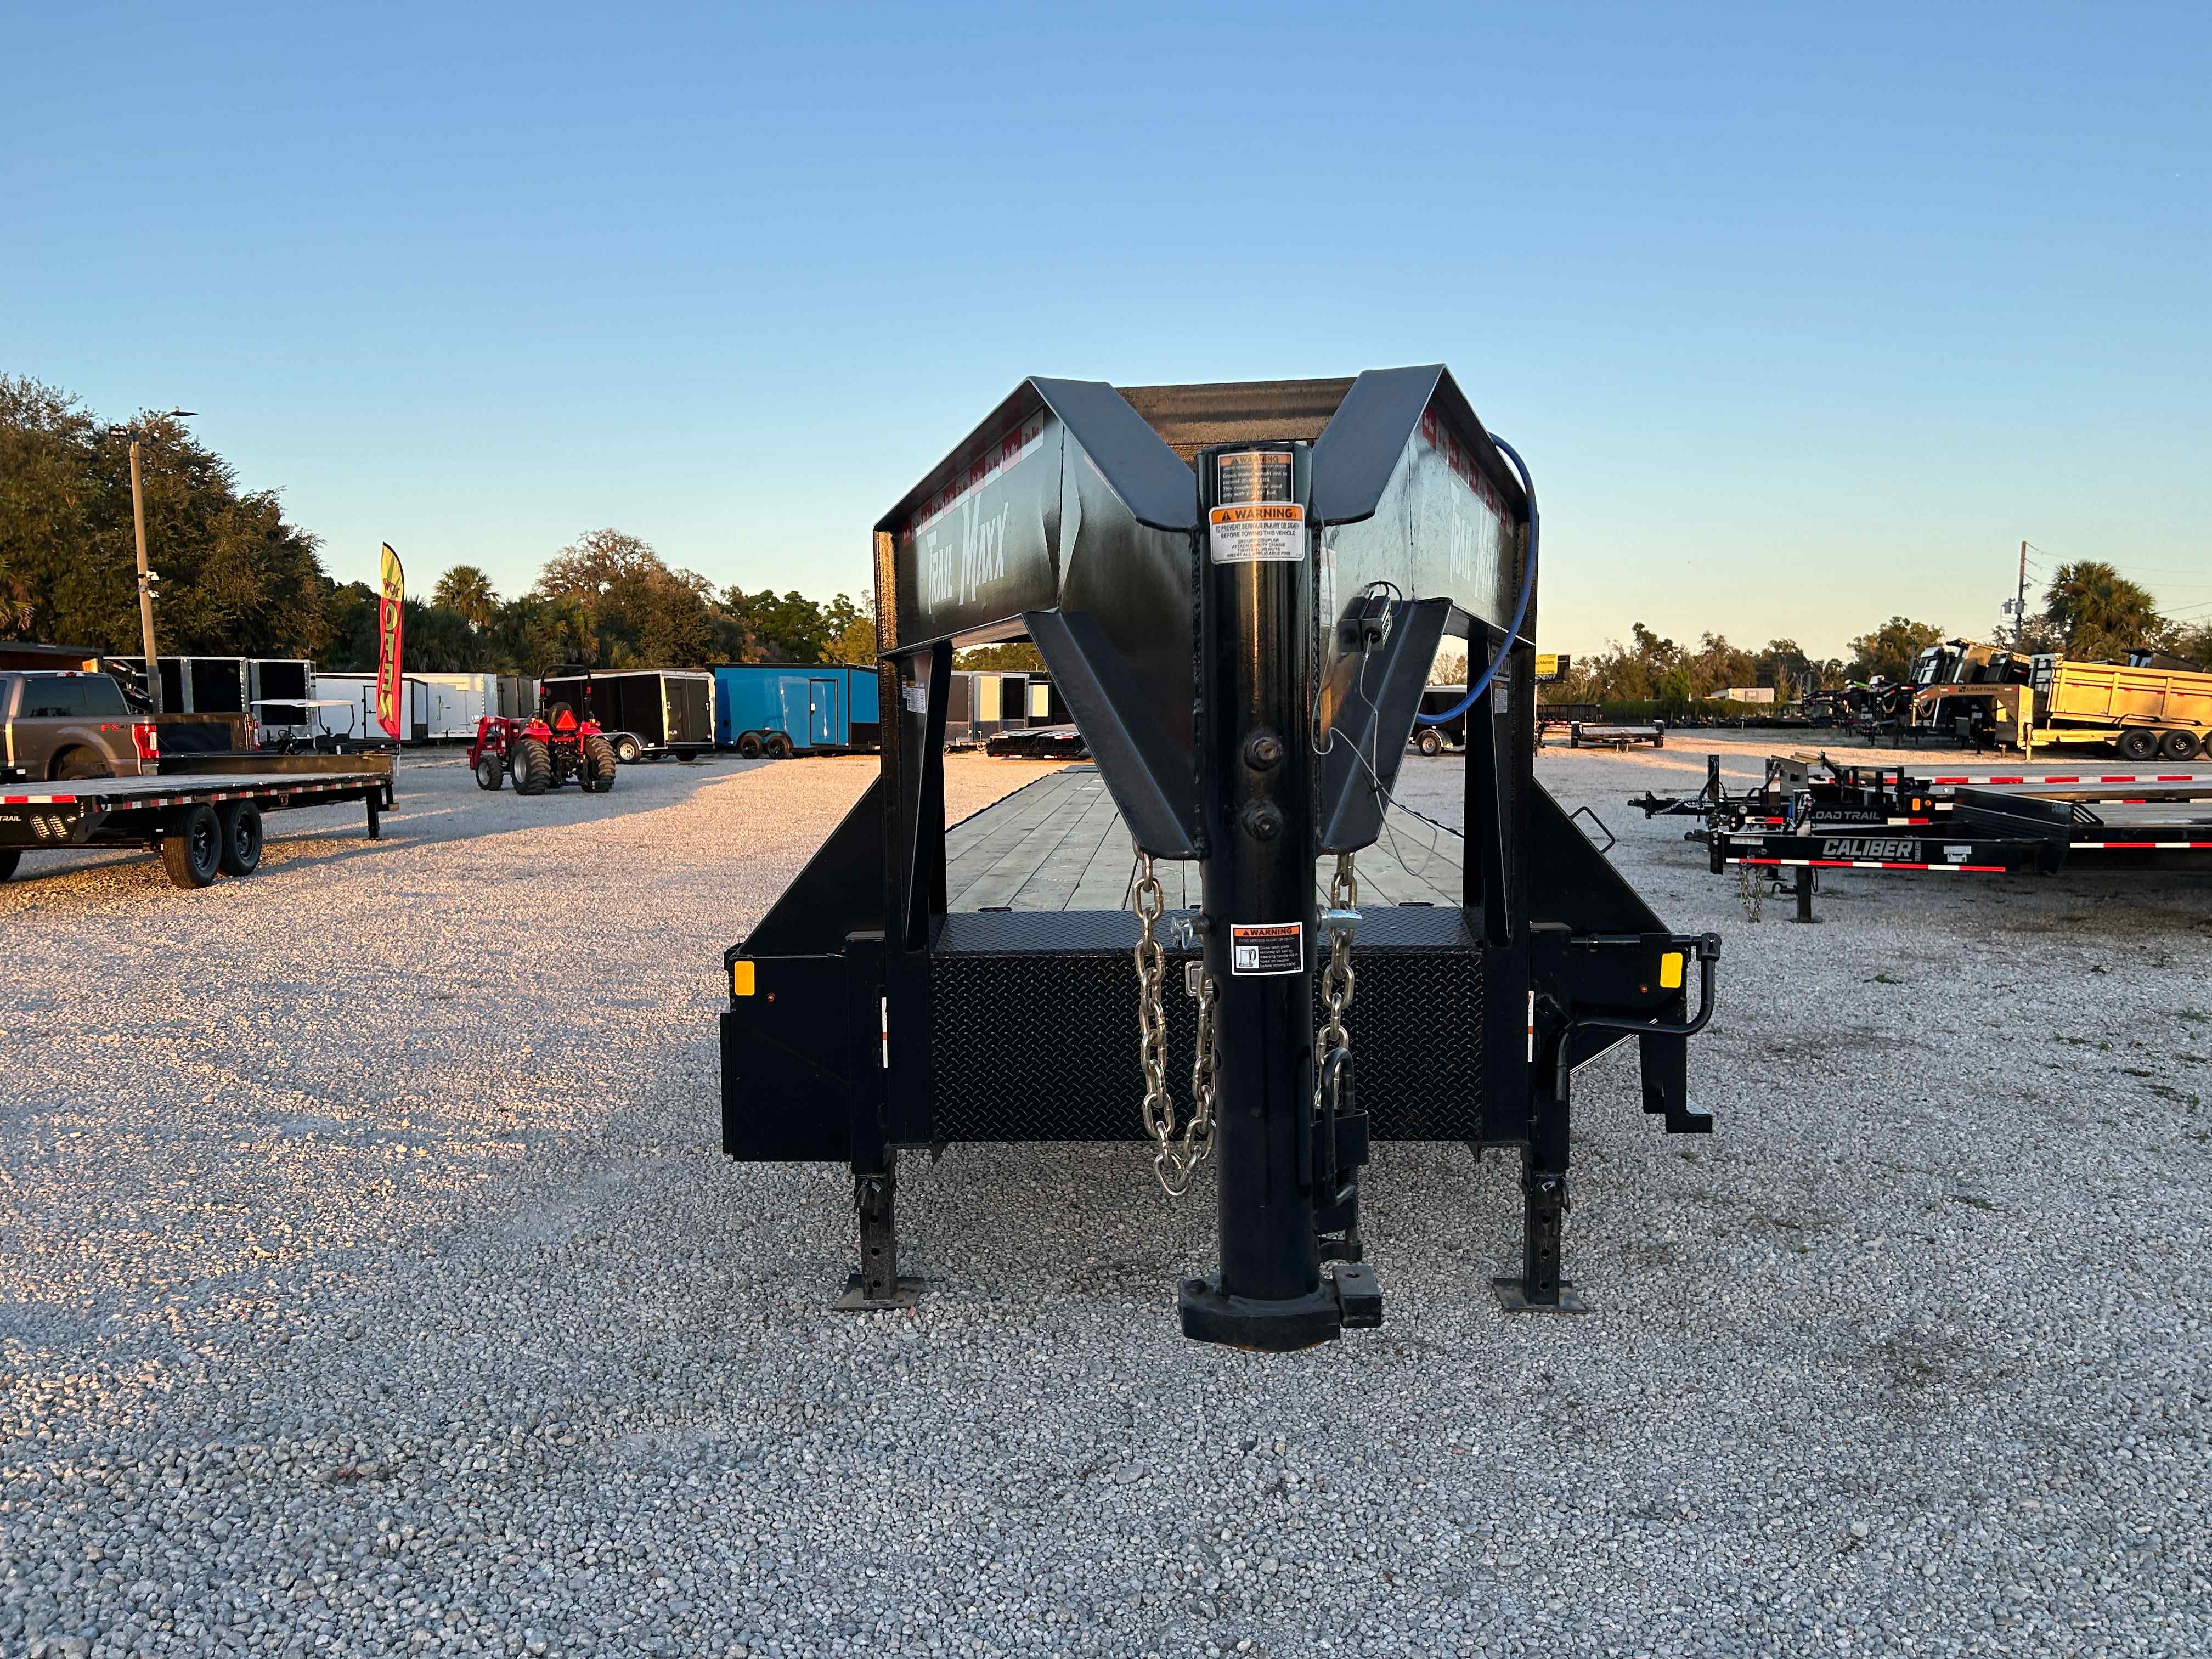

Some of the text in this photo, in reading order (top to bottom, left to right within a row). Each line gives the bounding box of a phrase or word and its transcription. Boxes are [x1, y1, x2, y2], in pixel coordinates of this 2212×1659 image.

[1235, 508, 1293, 519] WARNING
[926, 492, 1009, 616] TRAIL MAXX
[1844, 811, 1881, 820] TRAIL
[1822, 839, 1913, 857] CALIBER
[1250, 928, 1293, 936] WARNING
